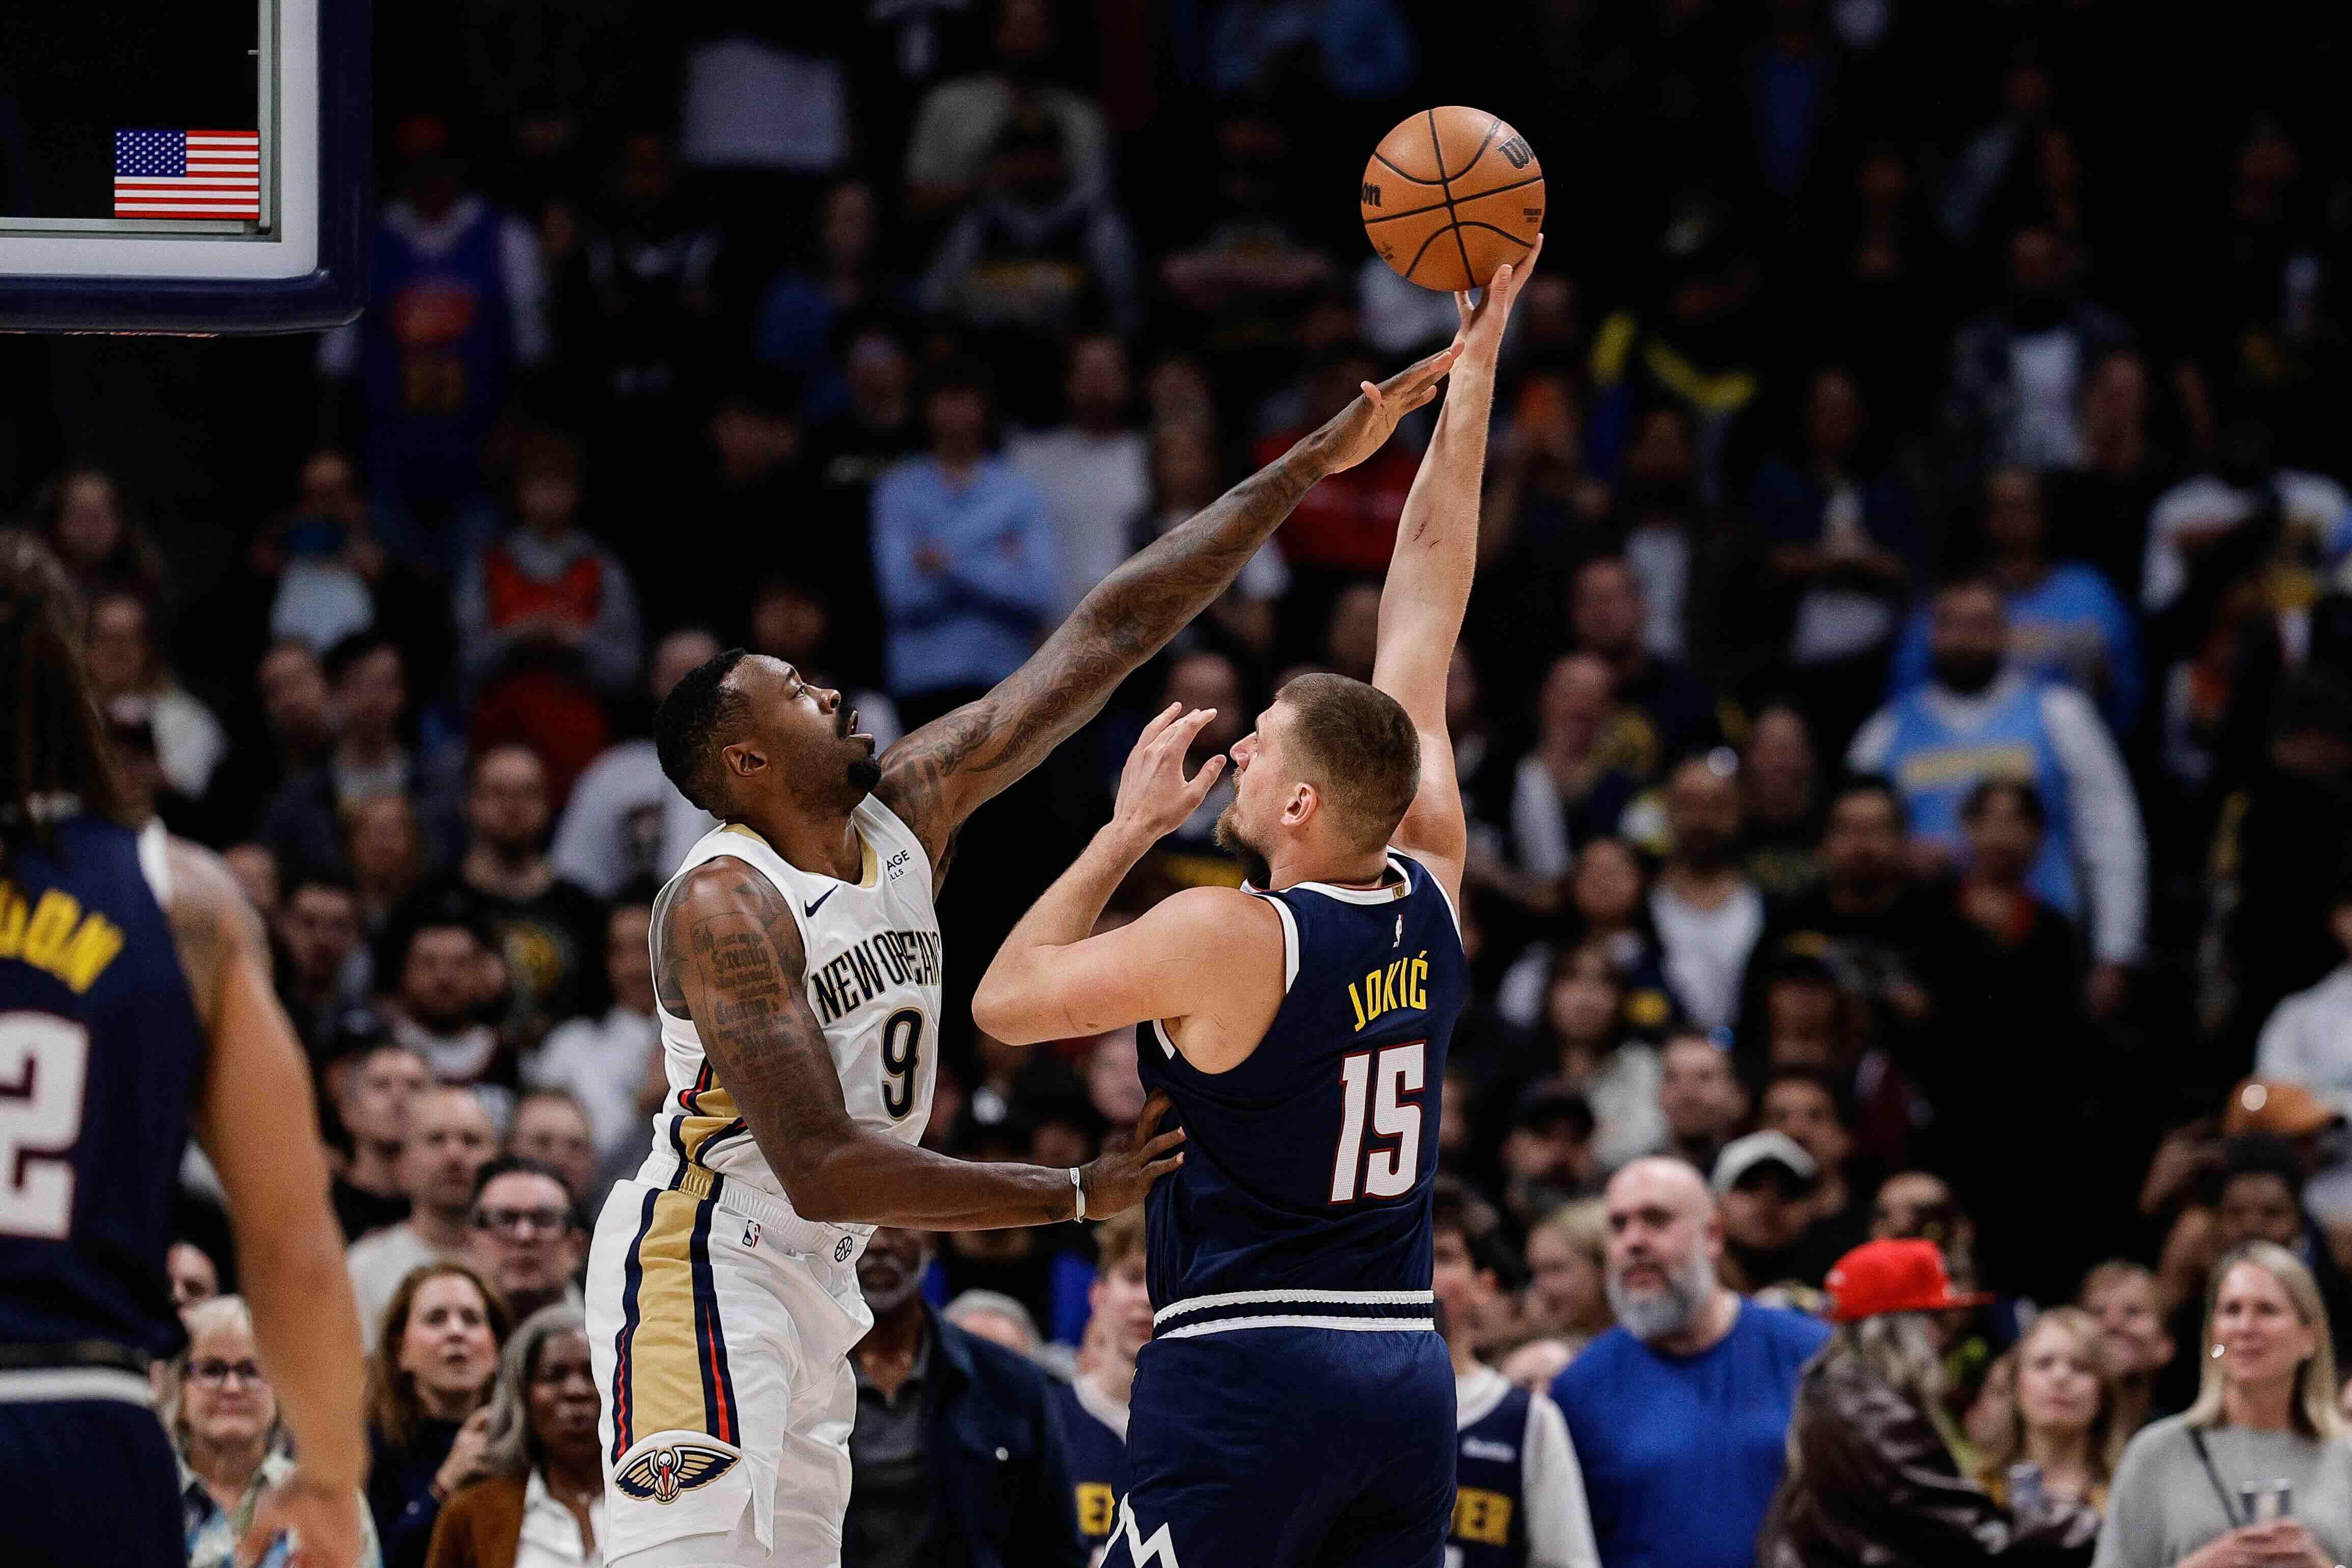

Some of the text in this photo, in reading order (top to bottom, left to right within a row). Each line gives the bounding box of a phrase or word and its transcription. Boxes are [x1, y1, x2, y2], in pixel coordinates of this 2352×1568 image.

[886, 850, 910, 872] AGE
[810, 938, 885, 1027] NEW
[1348, 950, 1427, 1032] JOKIĆ
[881, 1006, 925, 1122] 9
[0, 1010, 90, 1241] 2
[1328, 1039, 1427, 1206] 15
